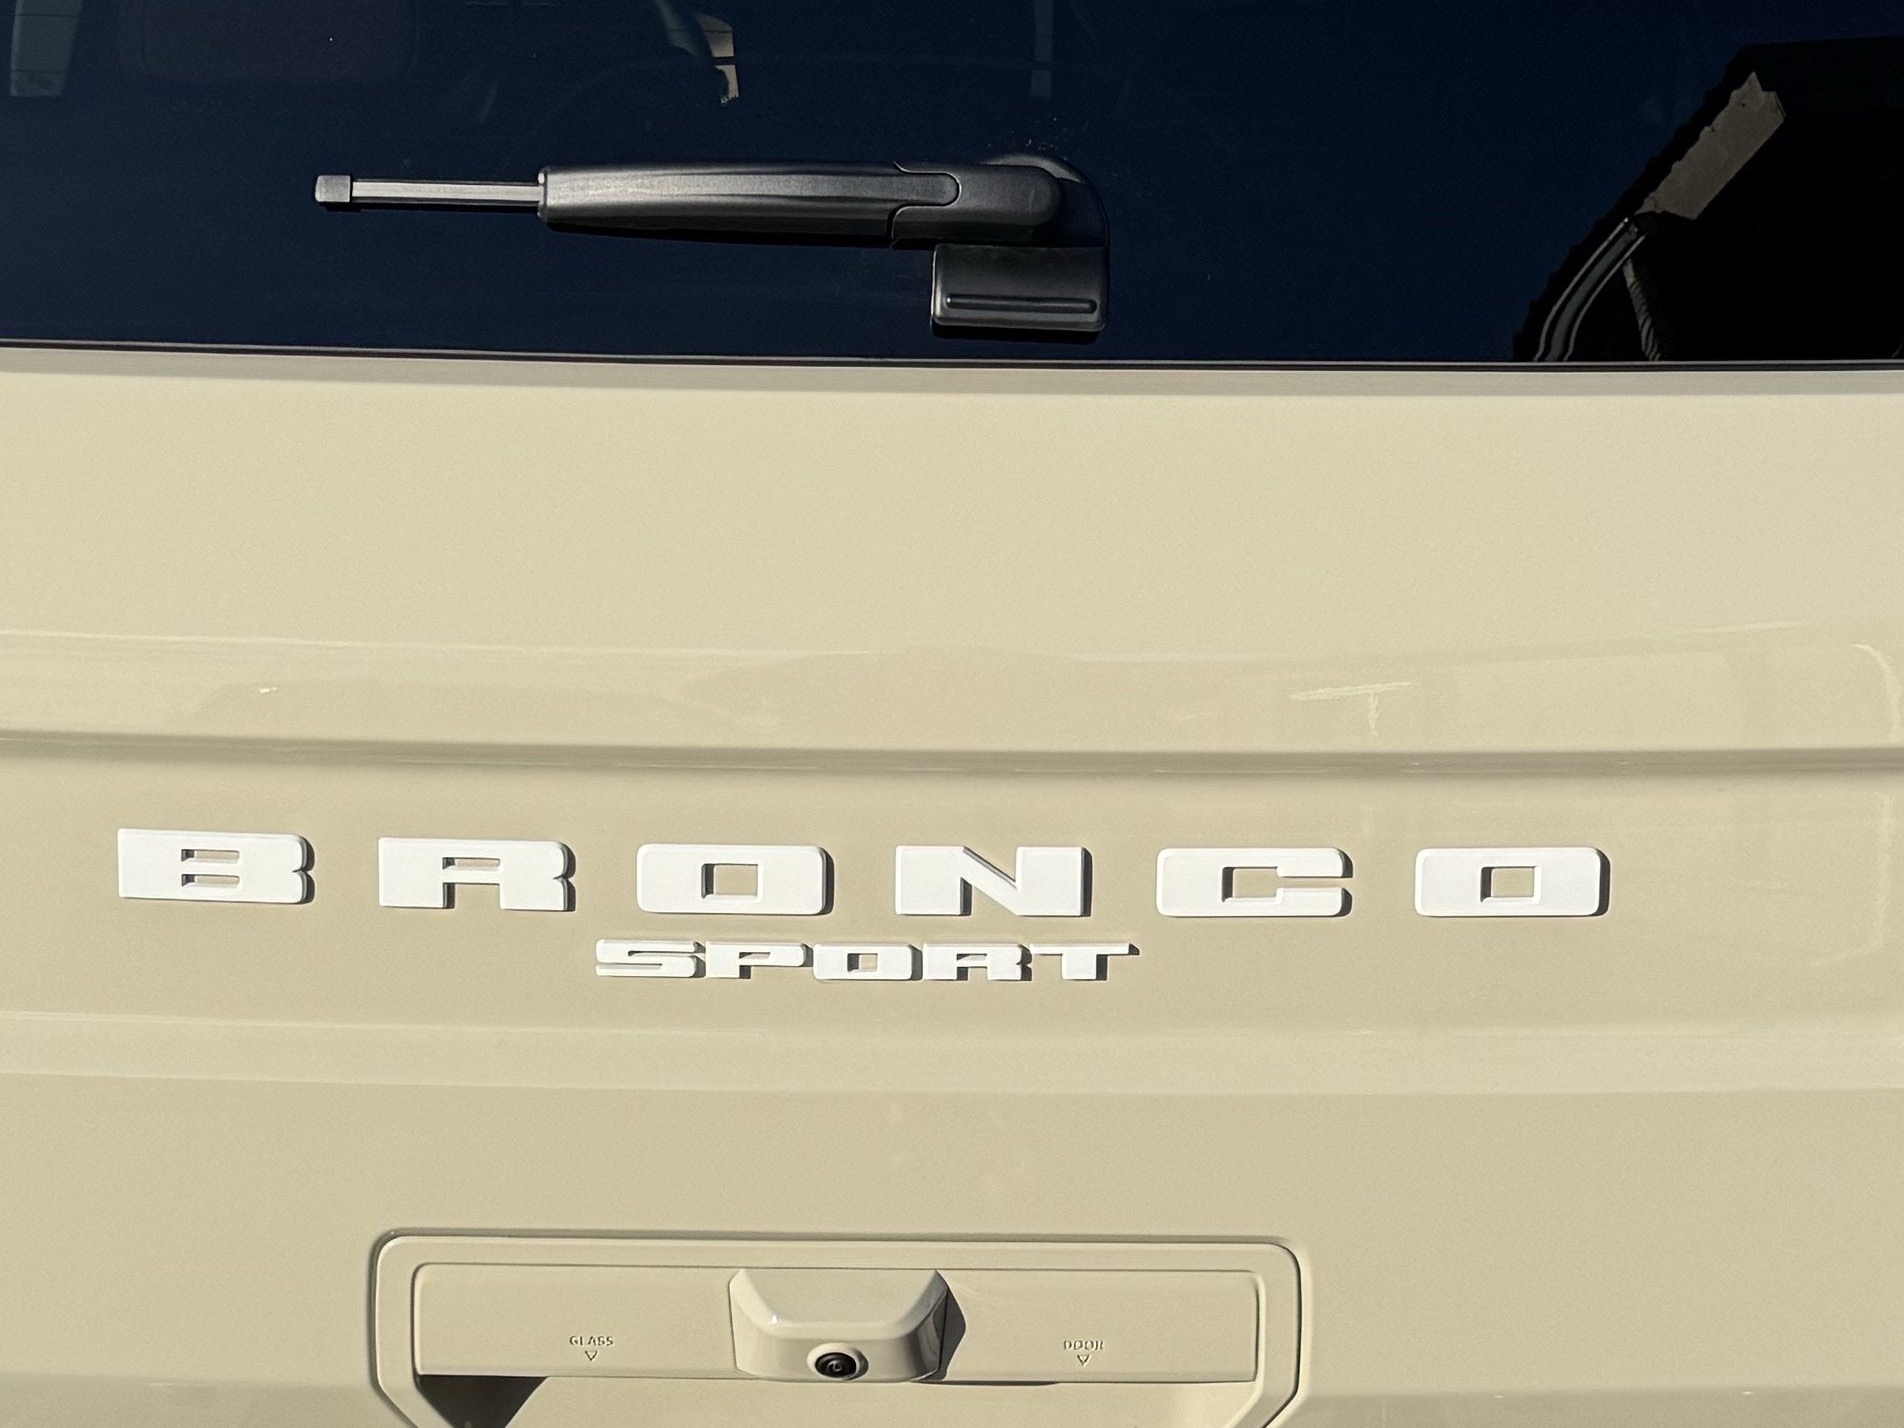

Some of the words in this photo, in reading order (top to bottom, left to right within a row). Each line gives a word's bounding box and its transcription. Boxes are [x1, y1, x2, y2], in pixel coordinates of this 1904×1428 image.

[116, 827, 1611, 918] BRONCO
[595, 938, 1140, 983] SPORT
[568, 1335, 615, 1347] GLASS
[1062, 1339, 1104, 1351] DOOR
